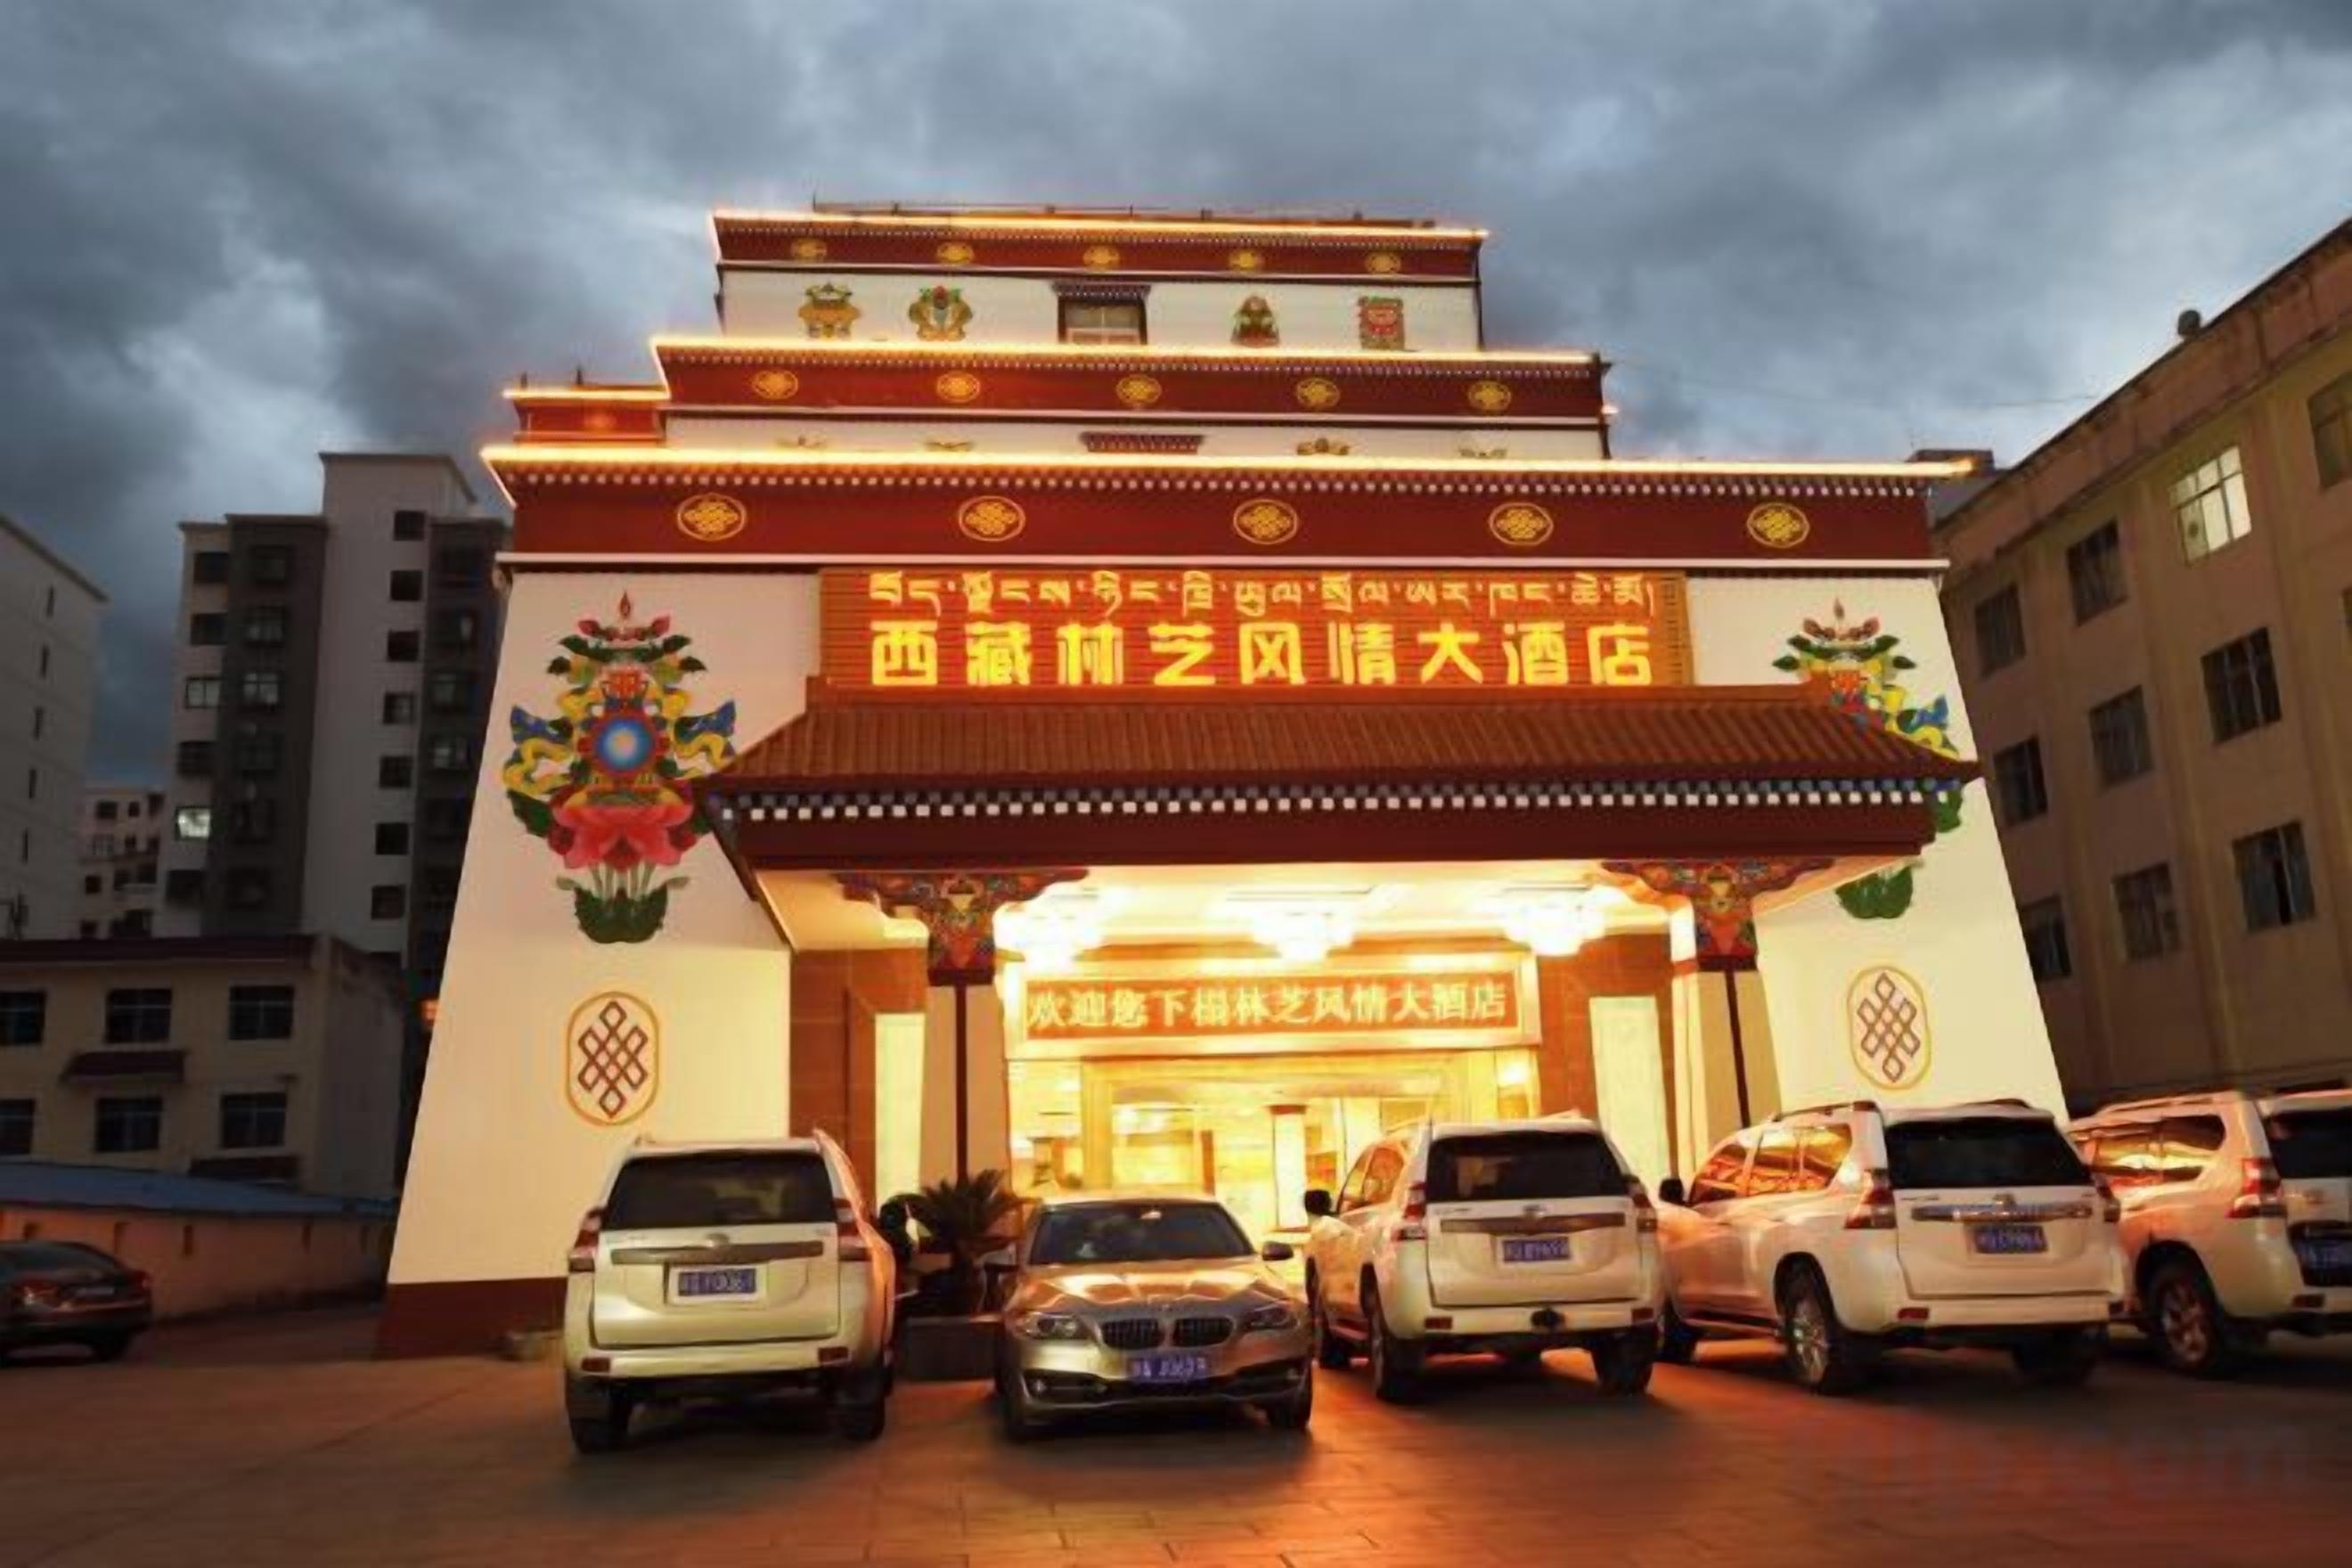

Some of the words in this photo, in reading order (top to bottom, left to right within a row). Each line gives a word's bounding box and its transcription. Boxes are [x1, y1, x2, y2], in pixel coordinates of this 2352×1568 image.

[870, 621, 1654, 686] 西藏林芝风情大酒店
[1027, 981, 1505, 1029] 欢迎您下榻林芝风情大酒店
